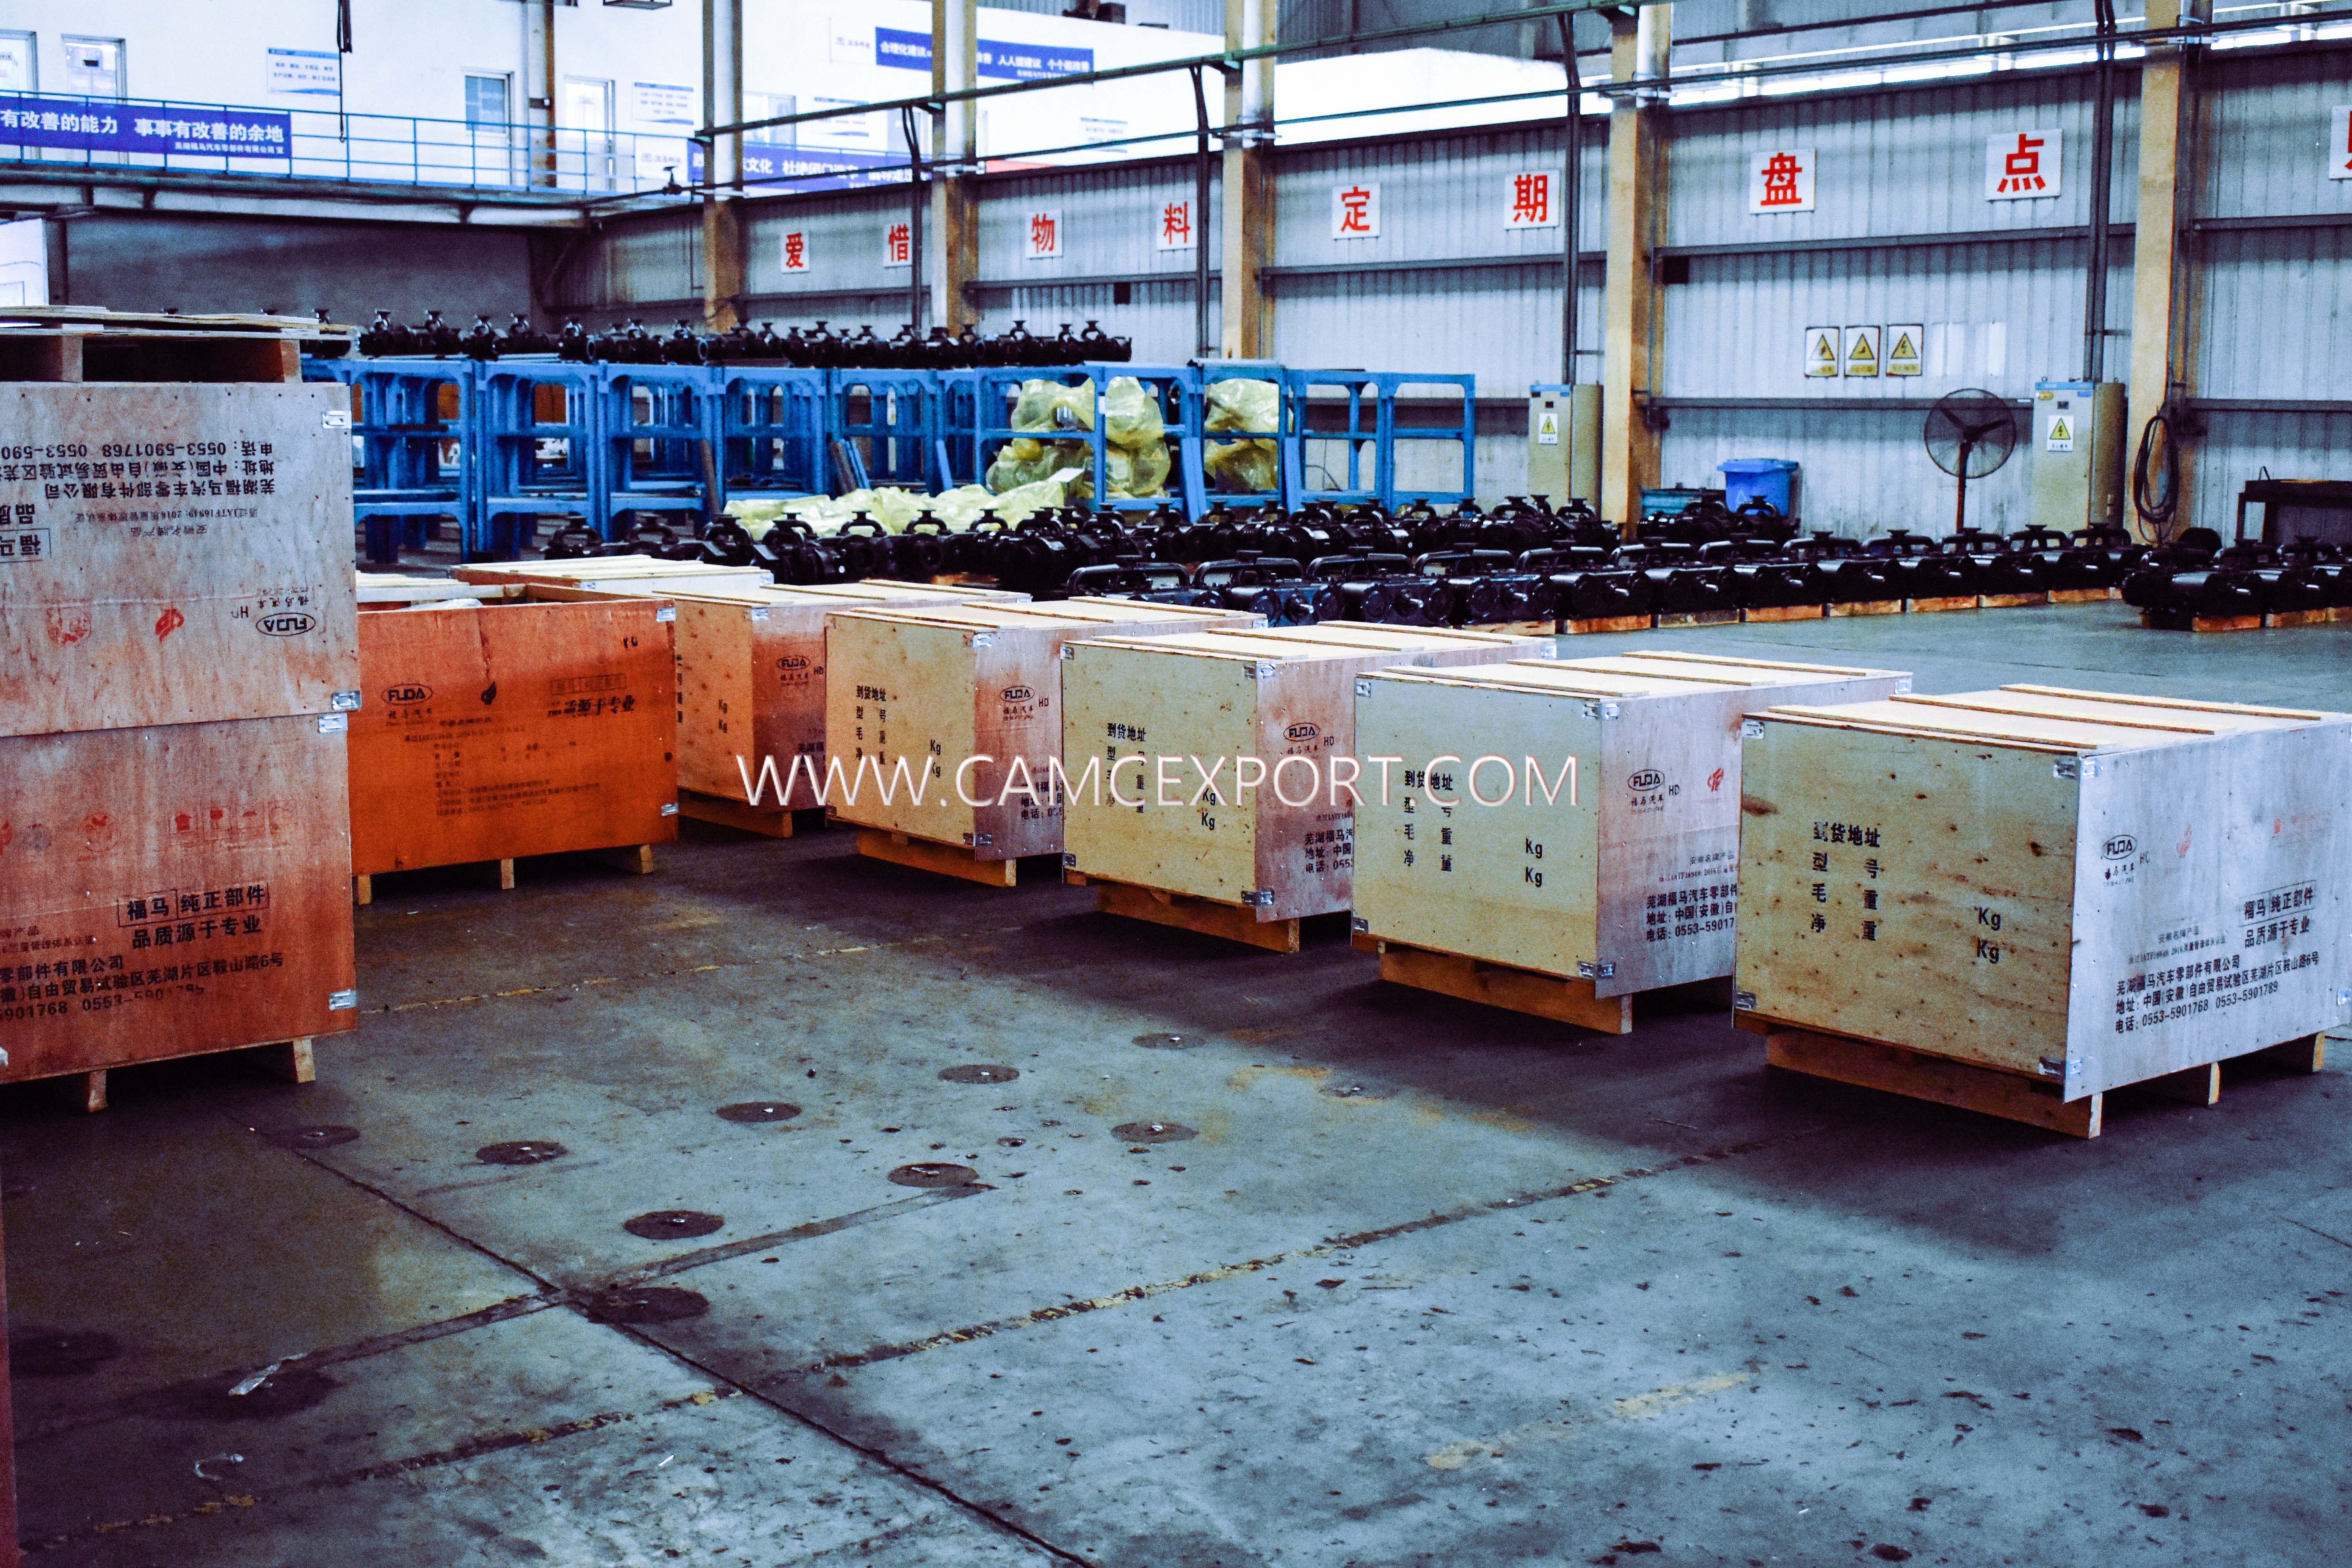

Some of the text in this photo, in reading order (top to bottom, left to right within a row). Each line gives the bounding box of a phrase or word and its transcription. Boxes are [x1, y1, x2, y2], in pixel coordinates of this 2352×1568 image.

[0, 109, 284, 142] 有改善的能力 事事有改善的余地
[743, 157, 773, 174] 文化
[786, 133, 2046, 268] 爱 惜 物 料 定 期 盘 点
[0, 459, 275, 481] 地址：中国(安徽)自由贸易试验区芜
[45, 478, 275, 499] 芜湖福马汽车零部件有限公司
[1038, 698, 1049, 708] HD
[1107, 722, 1146, 742] 到货地址
[1324, 736, 1334, 746] HD
[930, 739, 941, 756] Kg
[1107, 746, 1116, 761] 型
[1668, 784, 1680, 796] HD
[1201, 812, 1215, 831] Kg
[1404, 823, 1543, 859] 毛 重 Kg
[1813, 822, 1880, 848] 到货地址
[1305, 858, 1354, 873] 电话：055
[1525, 867, 1543, 887] Kg
[1812, 852, 1879, 879] 型 号
[127, 884, 265, 921] 福马 纯正部件
[1646, 883, 1737, 909] 芜湖福马汽车零部件
[1811, 883, 2001, 931] 毛 重 Kg
[2244, 886, 2313, 920] 福马 纯正部件
[1646, 900, 1737, 926] 地址：中国(安徽)自
[132, 915, 262, 949] 品质源于专业
[1811, 913, 2000, 964] 净 重 Kg
[2245, 915, 2310, 949] 品质源于专业
[2116, 954, 2240, 996] 芜湖福马汽车零部件有限公司
[2216, 980, 2278, 1009] 0553-5901789
[0, 1001, 67, 1020] 901768
